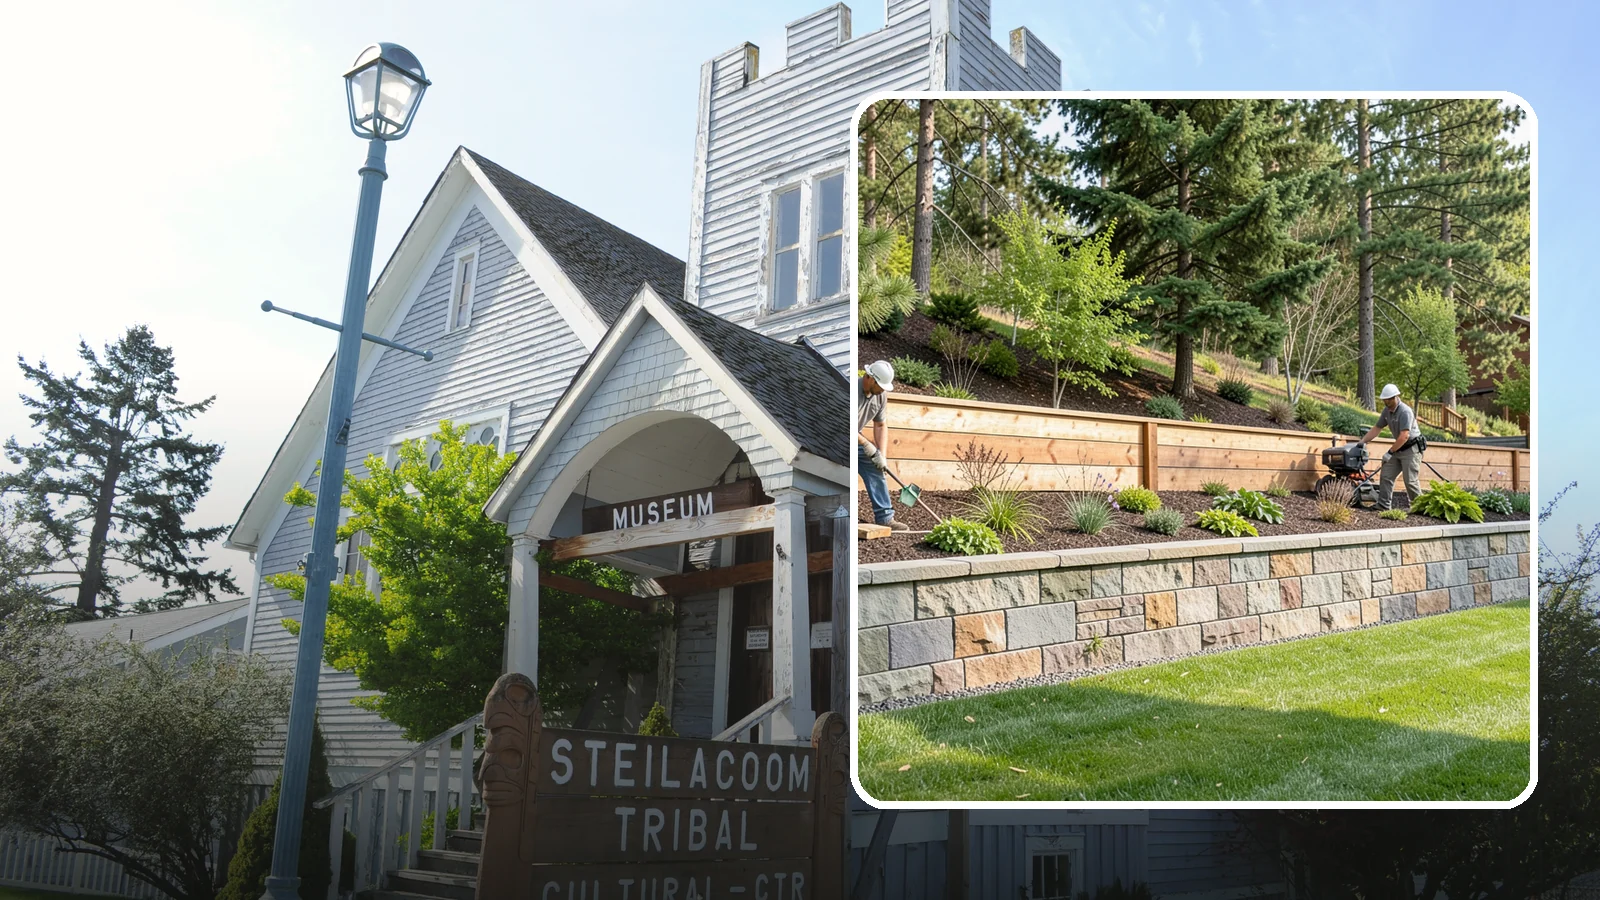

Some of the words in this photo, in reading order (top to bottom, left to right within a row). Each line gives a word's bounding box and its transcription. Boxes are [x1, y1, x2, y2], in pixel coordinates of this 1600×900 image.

[612, 491, 714, 531] MUSEUM
[550, 738, 810, 793] STEILACOOM
[615, 807, 757, 851] TRIBAL
